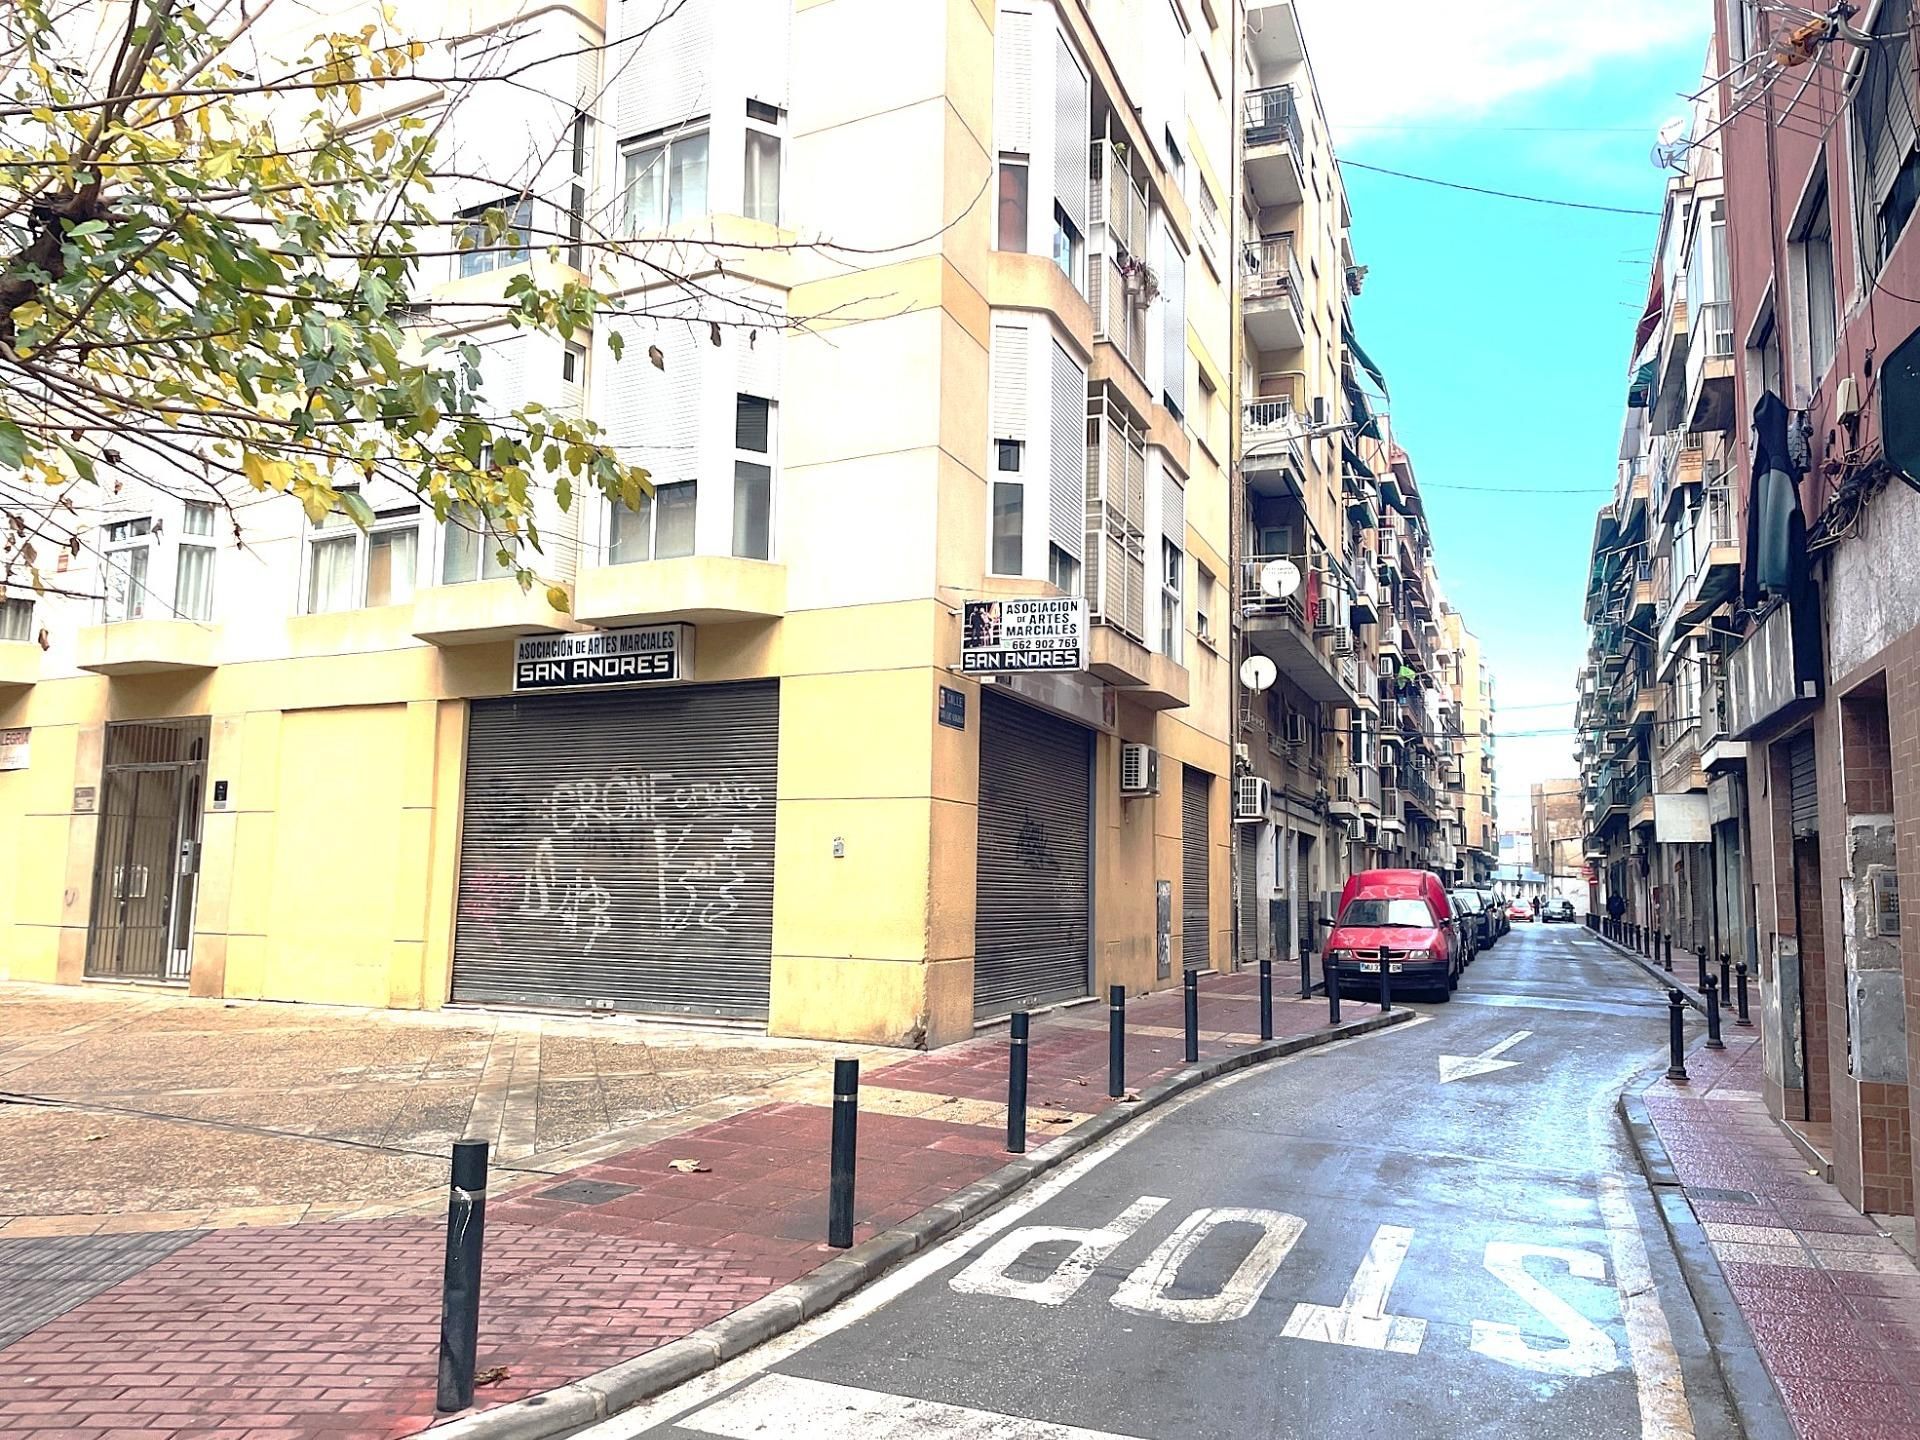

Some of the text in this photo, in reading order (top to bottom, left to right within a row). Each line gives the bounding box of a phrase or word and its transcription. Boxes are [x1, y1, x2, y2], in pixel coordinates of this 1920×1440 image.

[1006, 601, 1078, 614] ASOCIACION
[1029, 613, 1070, 624] ARTES
[1006, 624, 1077, 636] MARCIALES
[518, 631, 674, 660] ASOCIACION DE ARTES MARCIALES
[1012, 638, 1077, 649] 662 902 769
[965, 650, 1077, 668] SAN ANDRES
[520, 654, 669, 682] SAN ANDRES
[948, 1196, 1631, 1378] STOP
